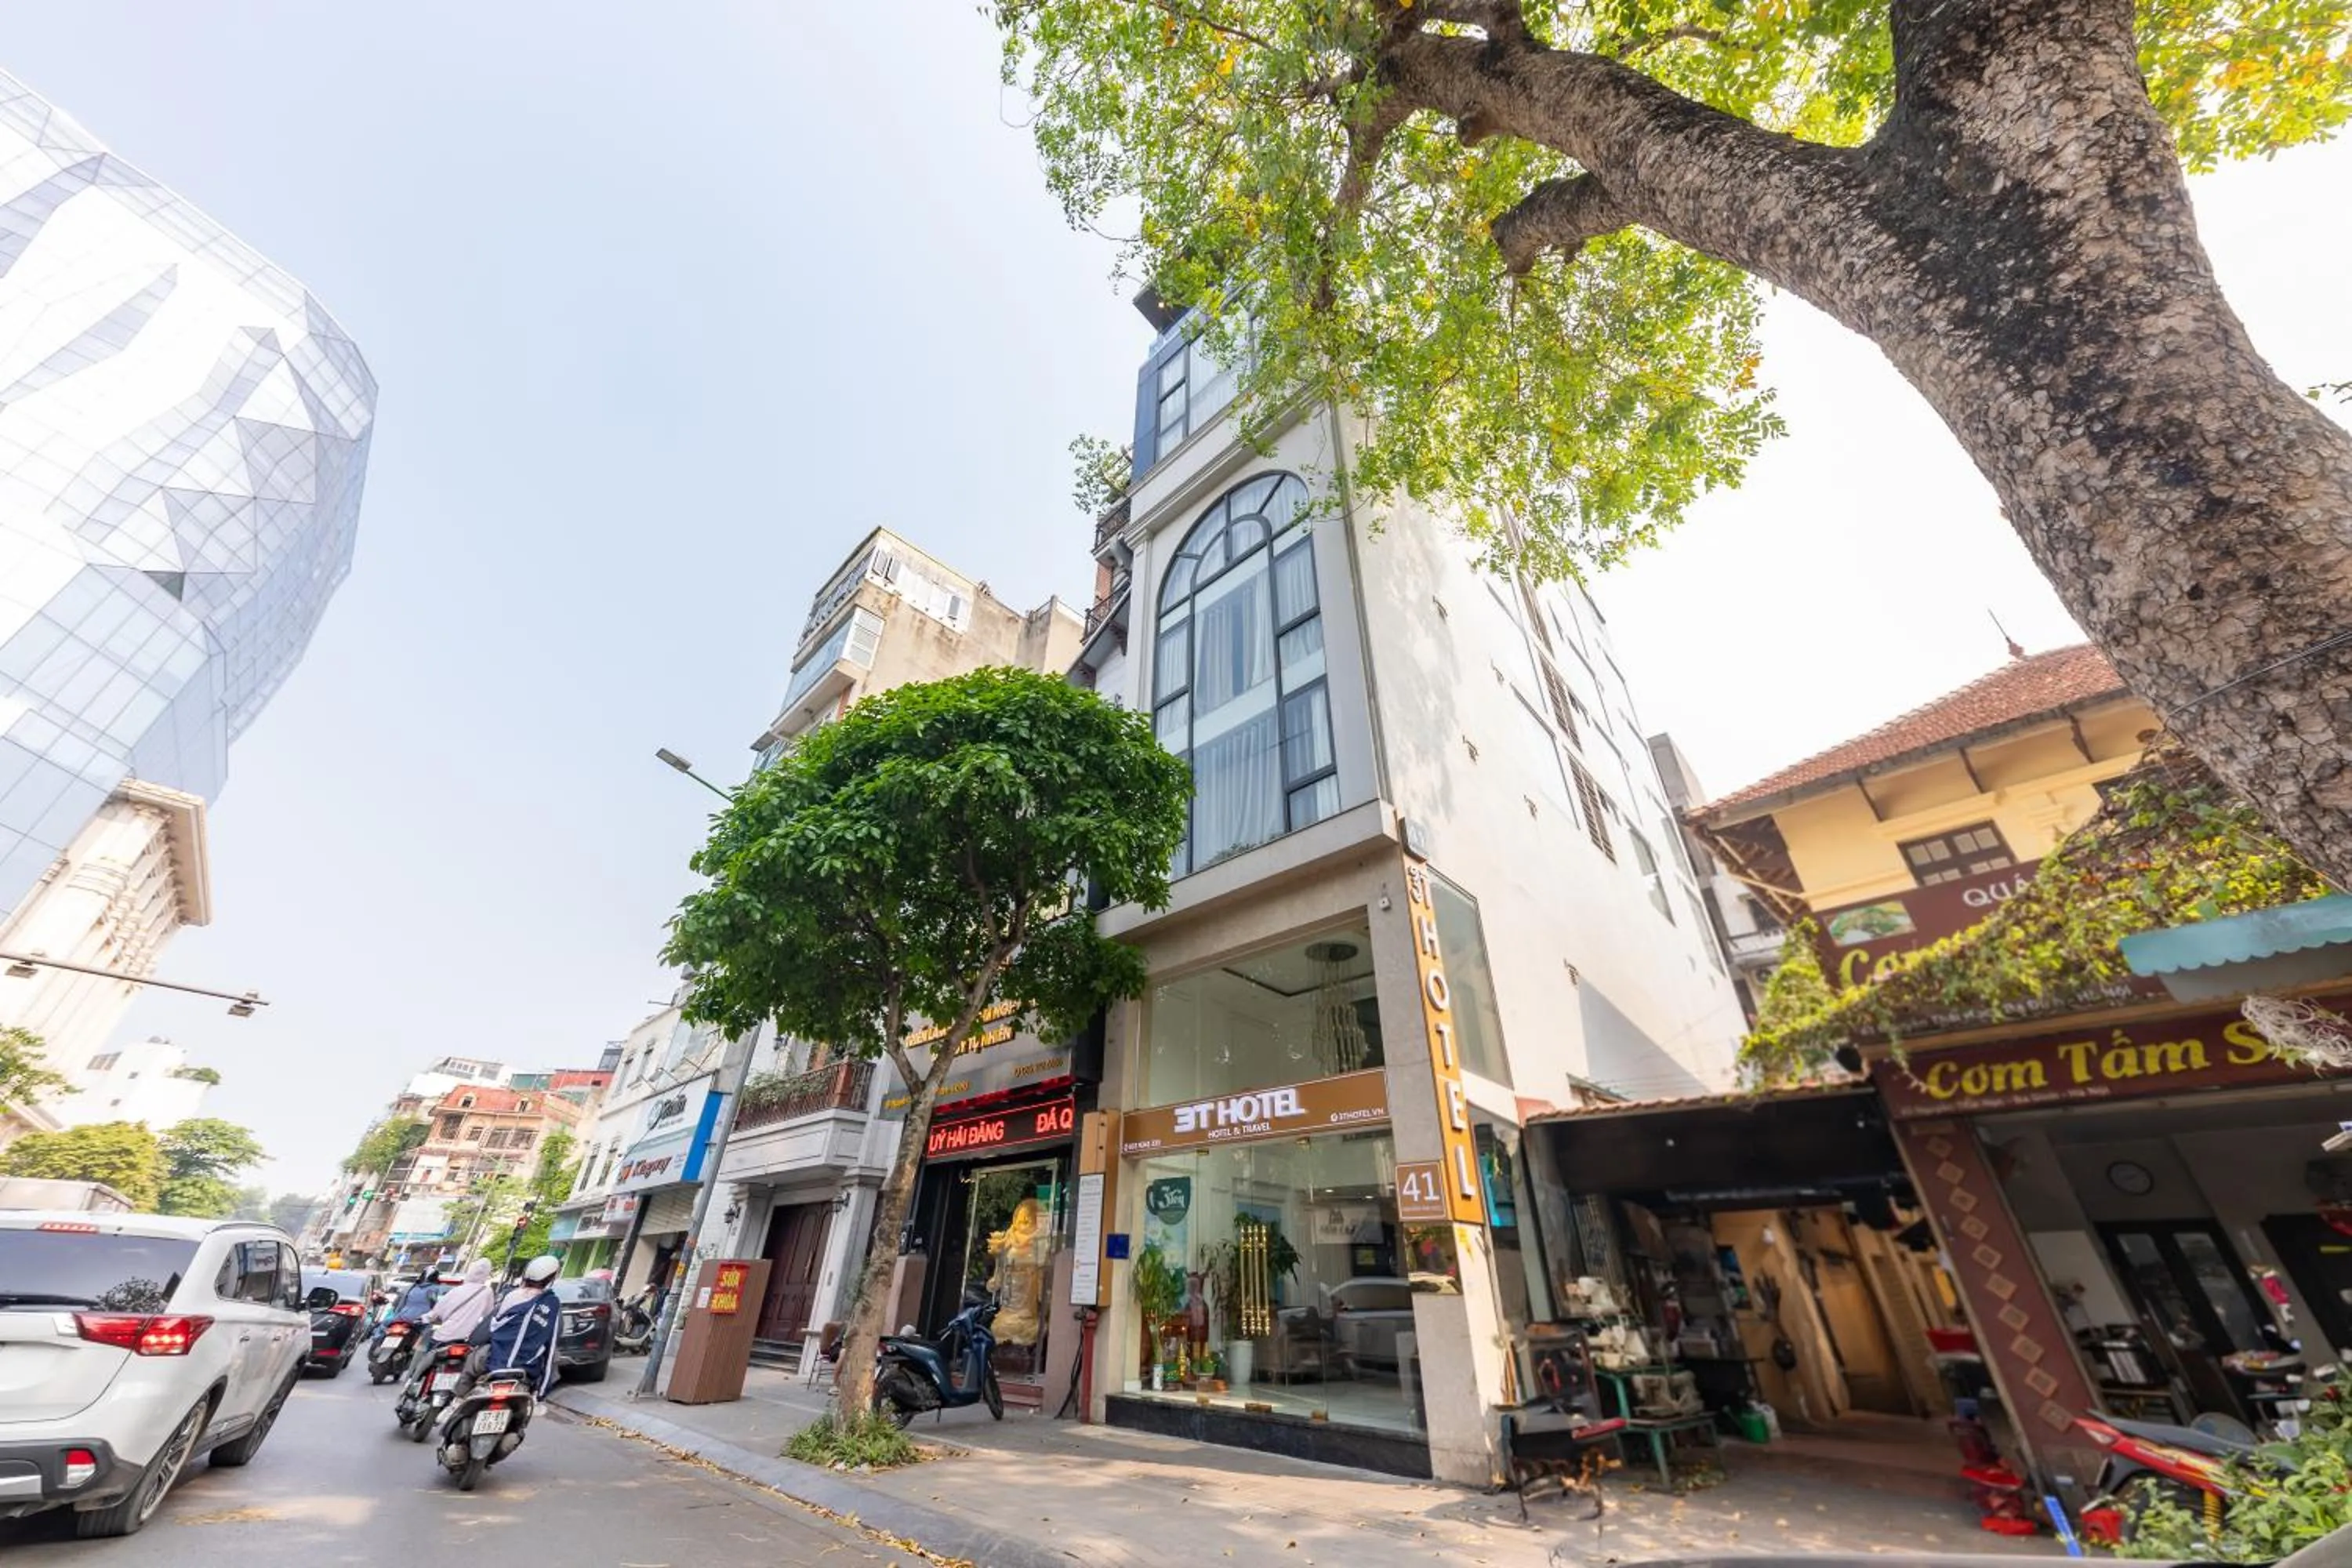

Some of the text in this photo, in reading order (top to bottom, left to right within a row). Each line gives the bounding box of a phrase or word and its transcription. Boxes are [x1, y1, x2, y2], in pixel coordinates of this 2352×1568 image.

[1417, 914, 1476, 1200] HOTEL
[1927, 1058, 2048, 1098] Cơm
[2058, 1029, 2211, 1083] Tấm
[1218, 1087, 1306, 1125] HOTEL
[1403, 1171, 1440, 1202] 41
